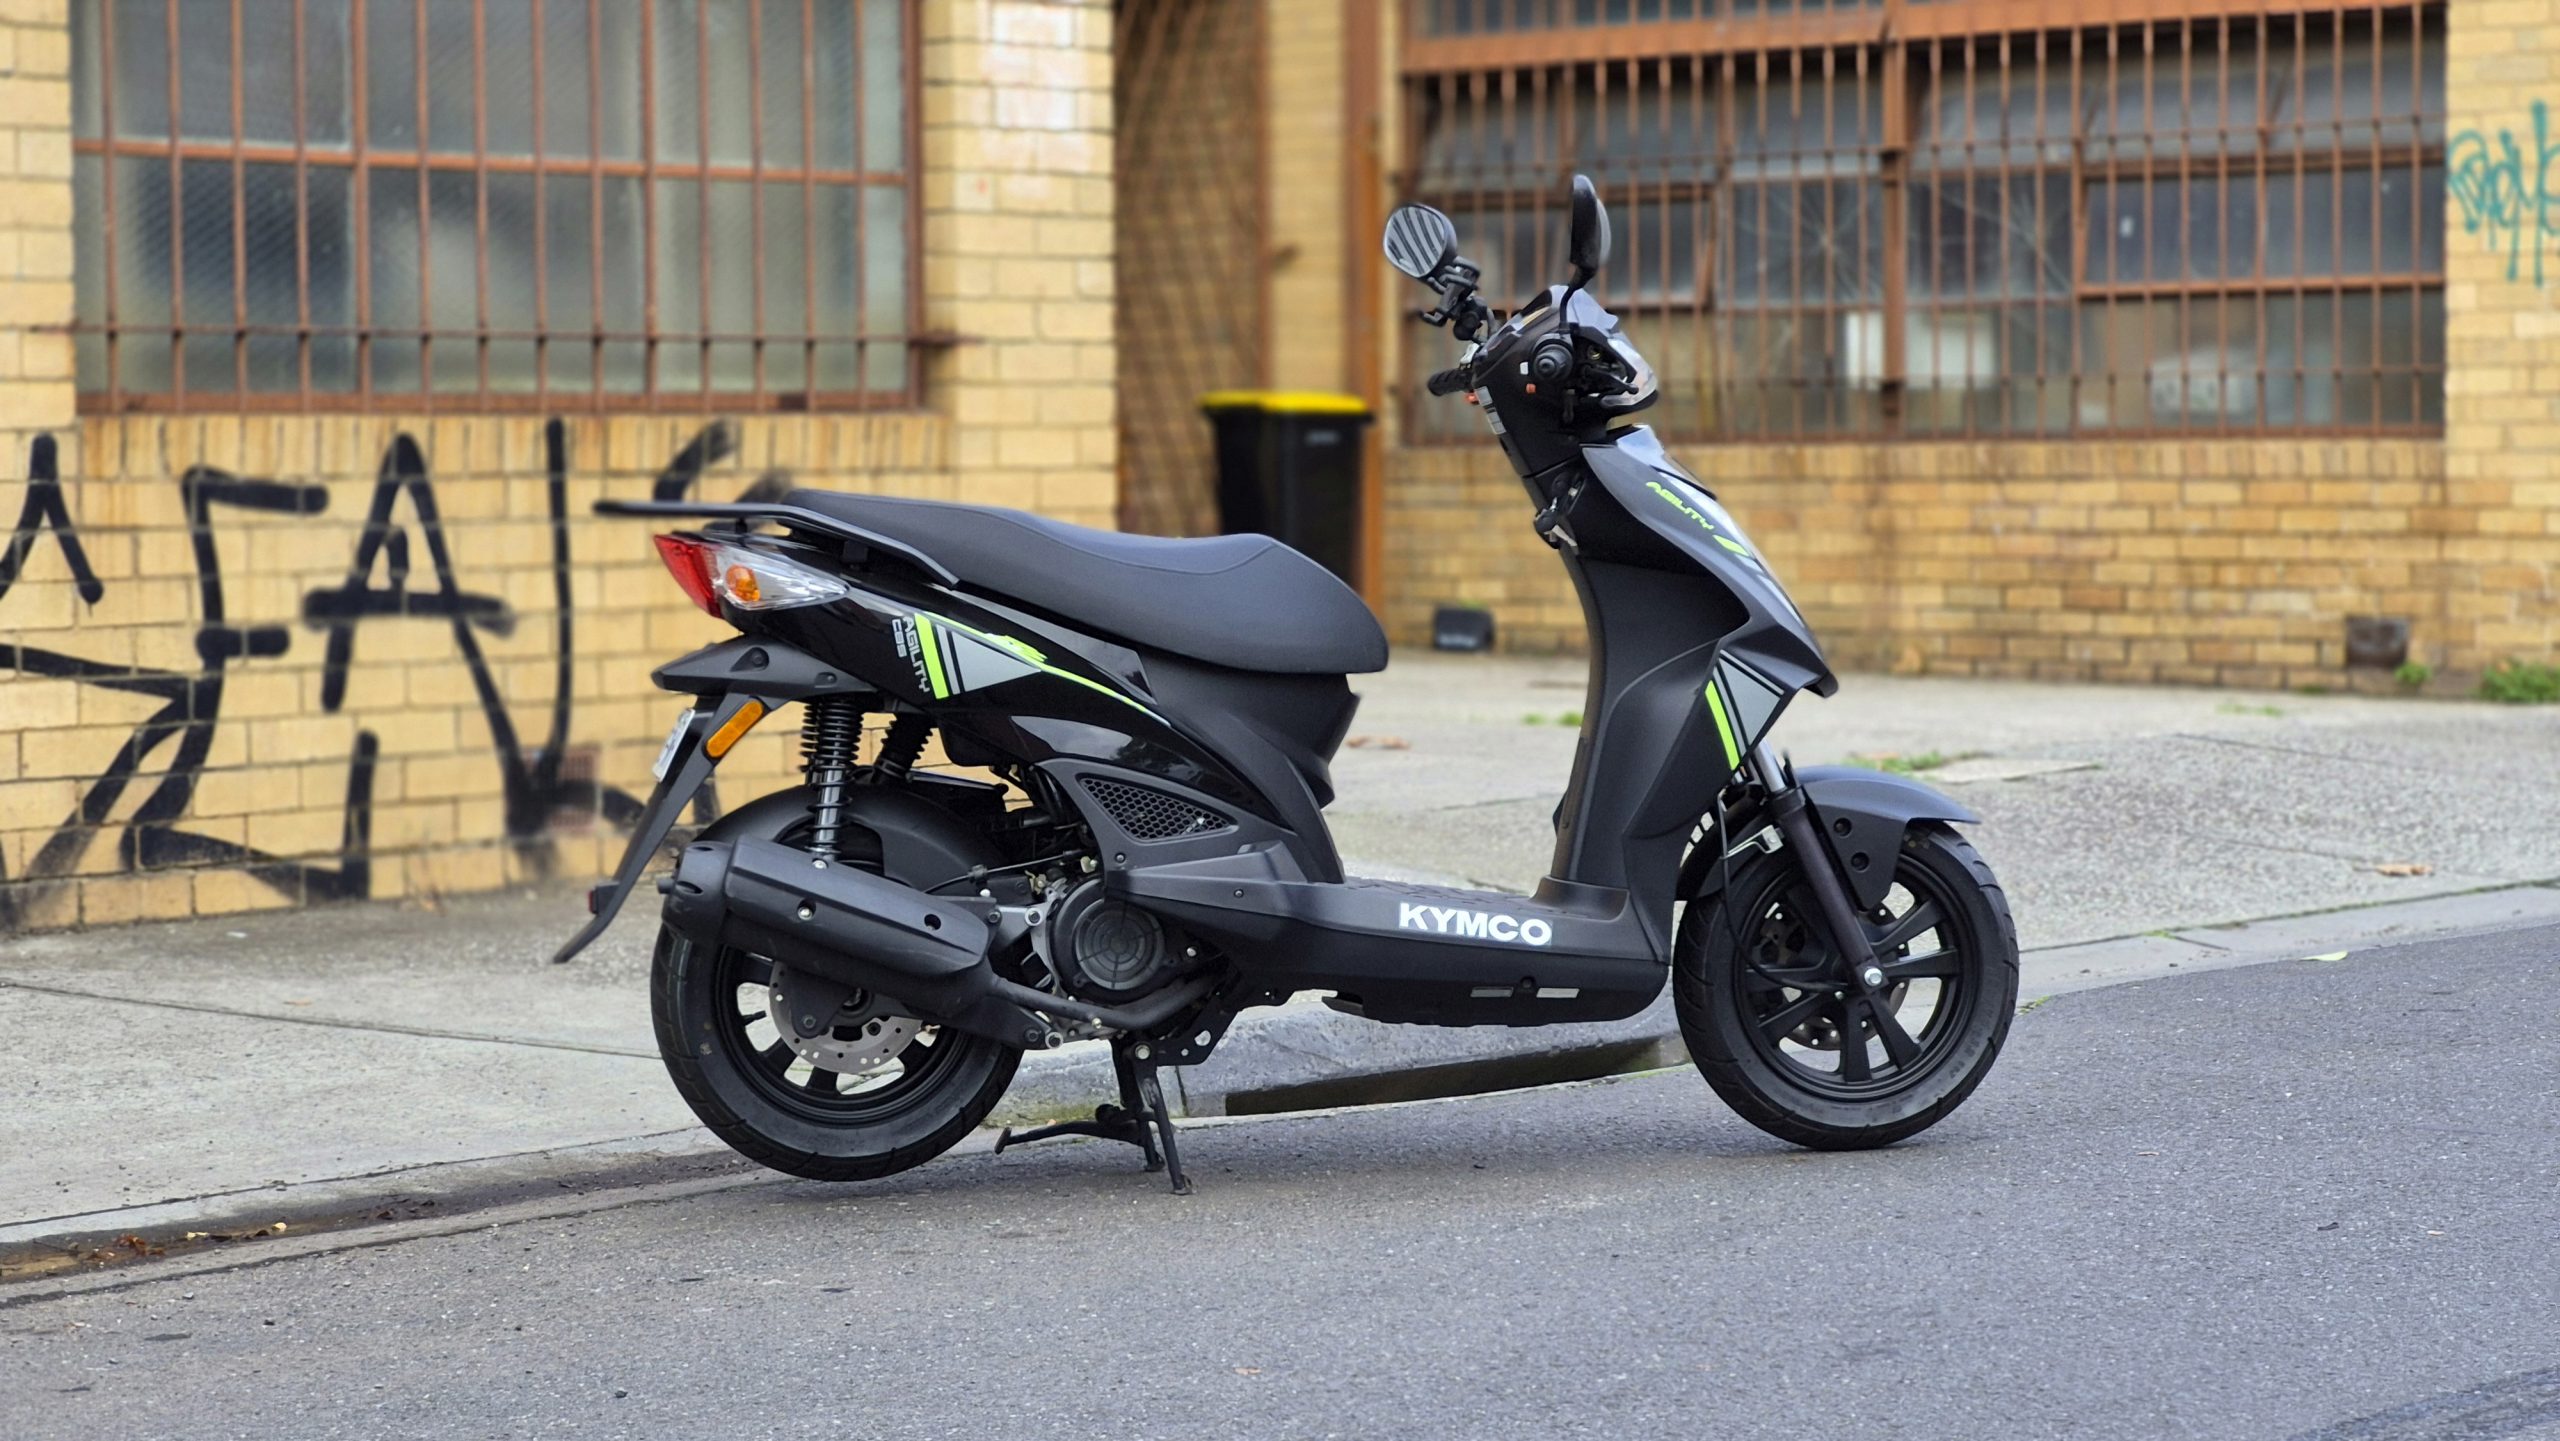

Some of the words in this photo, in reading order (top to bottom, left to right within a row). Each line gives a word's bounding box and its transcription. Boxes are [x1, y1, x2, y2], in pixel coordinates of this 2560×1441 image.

[1645, 481, 1715, 530] AGILITY
[891, 618, 907, 658] CBS
[902, 616, 930, 693] AGILITY
[1398, 902, 1552, 947] KYMCO
